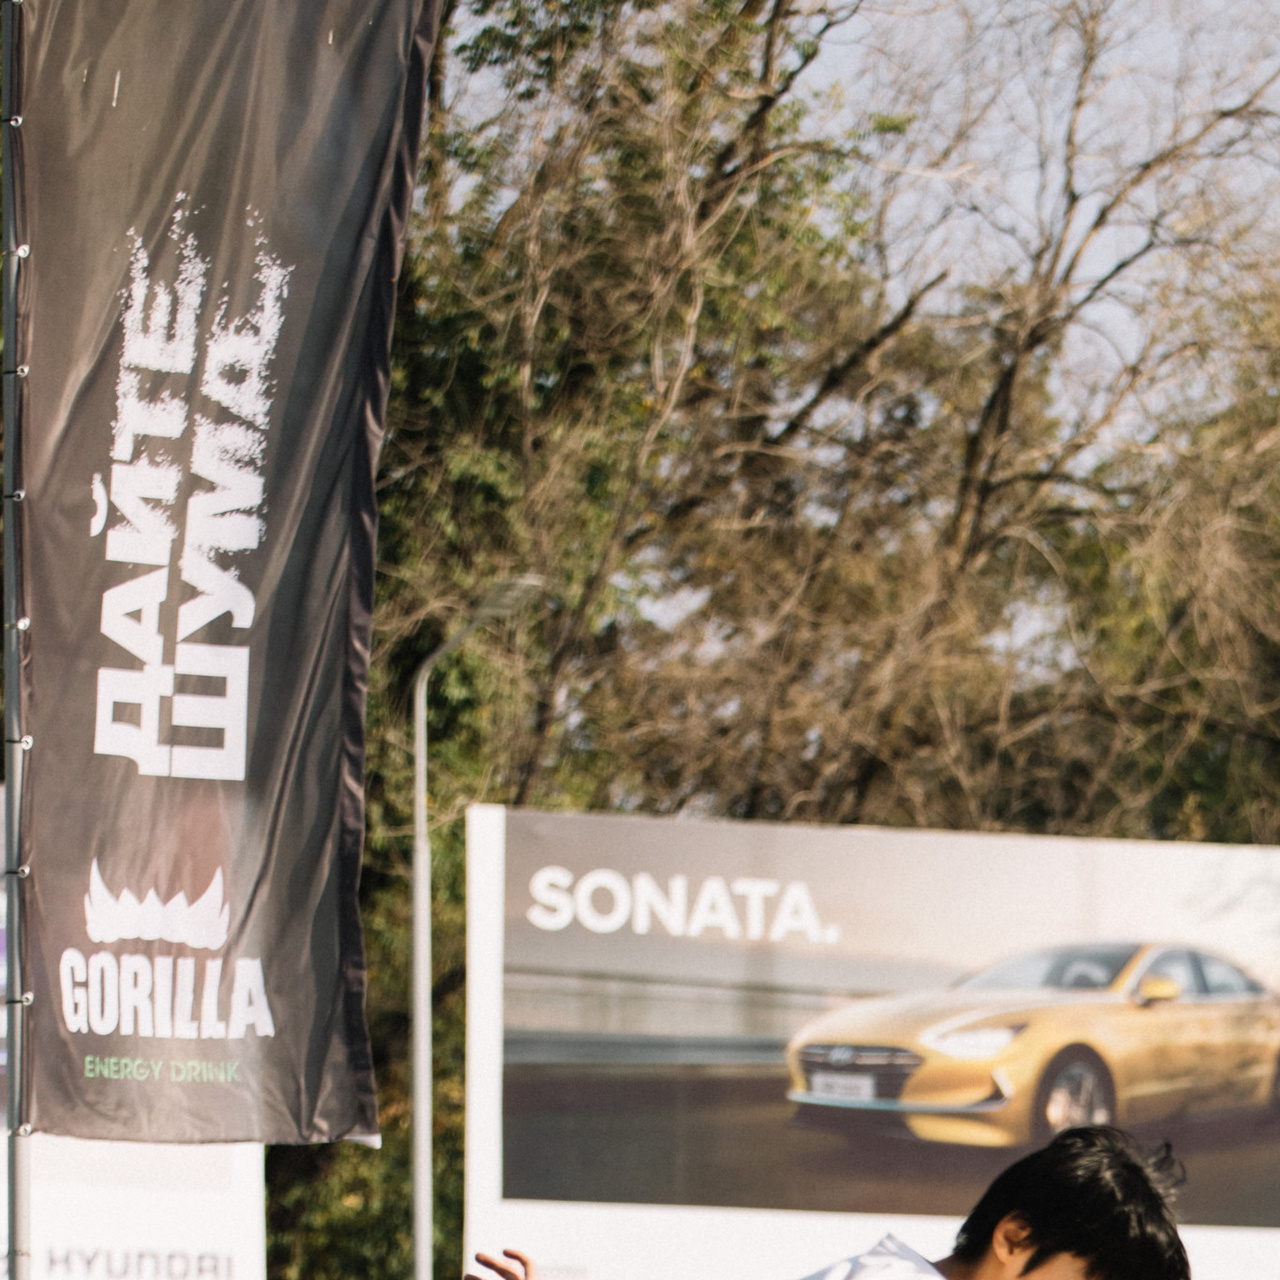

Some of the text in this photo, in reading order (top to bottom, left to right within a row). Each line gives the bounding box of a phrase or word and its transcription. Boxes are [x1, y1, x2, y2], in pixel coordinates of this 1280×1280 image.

[90, 192, 210, 776] ДАЙТЕ
[167, 204, 295, 781] ШУМА
[526, 865, 840, 944] SONATA.
[59, 947, 276, 1040] GORILLA
[84, 1054, 241, 1083] ENERGY DRINK
